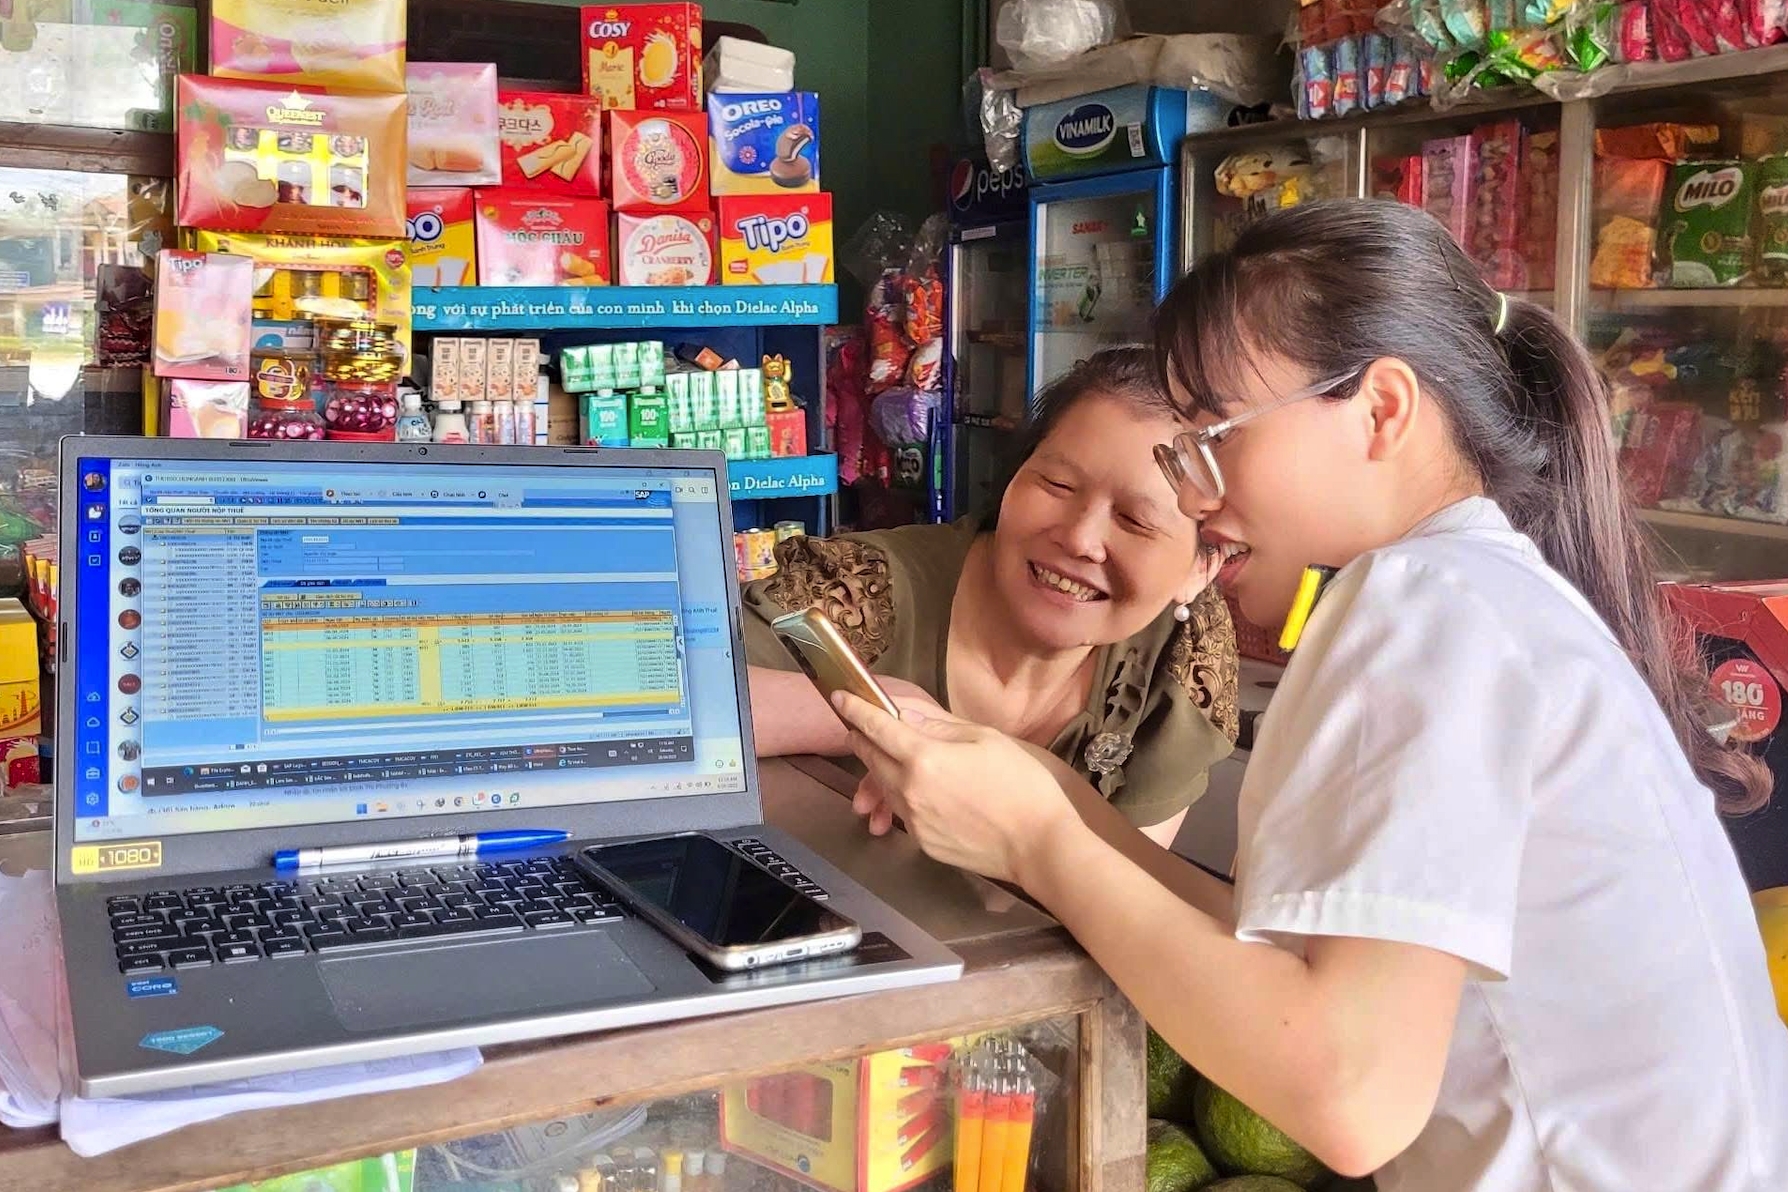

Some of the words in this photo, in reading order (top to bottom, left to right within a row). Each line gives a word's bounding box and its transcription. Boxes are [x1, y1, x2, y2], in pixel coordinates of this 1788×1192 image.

[589, 21, 631, 39] COSY
[721, 98, 783, 123] OREO
[1058, 114, 1112, 140] VINAMILK
[976, 162, 1025, 202] peps
[1683, 179, 1735, 201] MILO
[642, 253, 695, 266] CRANBERRY
[443, 302, 466, 315] với
[491, 301, 525, 320] phát
[597, 304, 624, 315] con
[671, 300, 694, 314] khi
[697, 300, 732, 316] chọn
[735, 300, 777, 314] Dielac
[780, 300, 819, 318] Alpha
[745, 475, 785, 490] Dielac
[787, 473, 825, 491] Alpha
[635, 490, 650, 499] SAP
[1720, 679, 1765, 706] 180
[108, 847, 152, 866] 1080
[138, 943, 158, 951] shift
